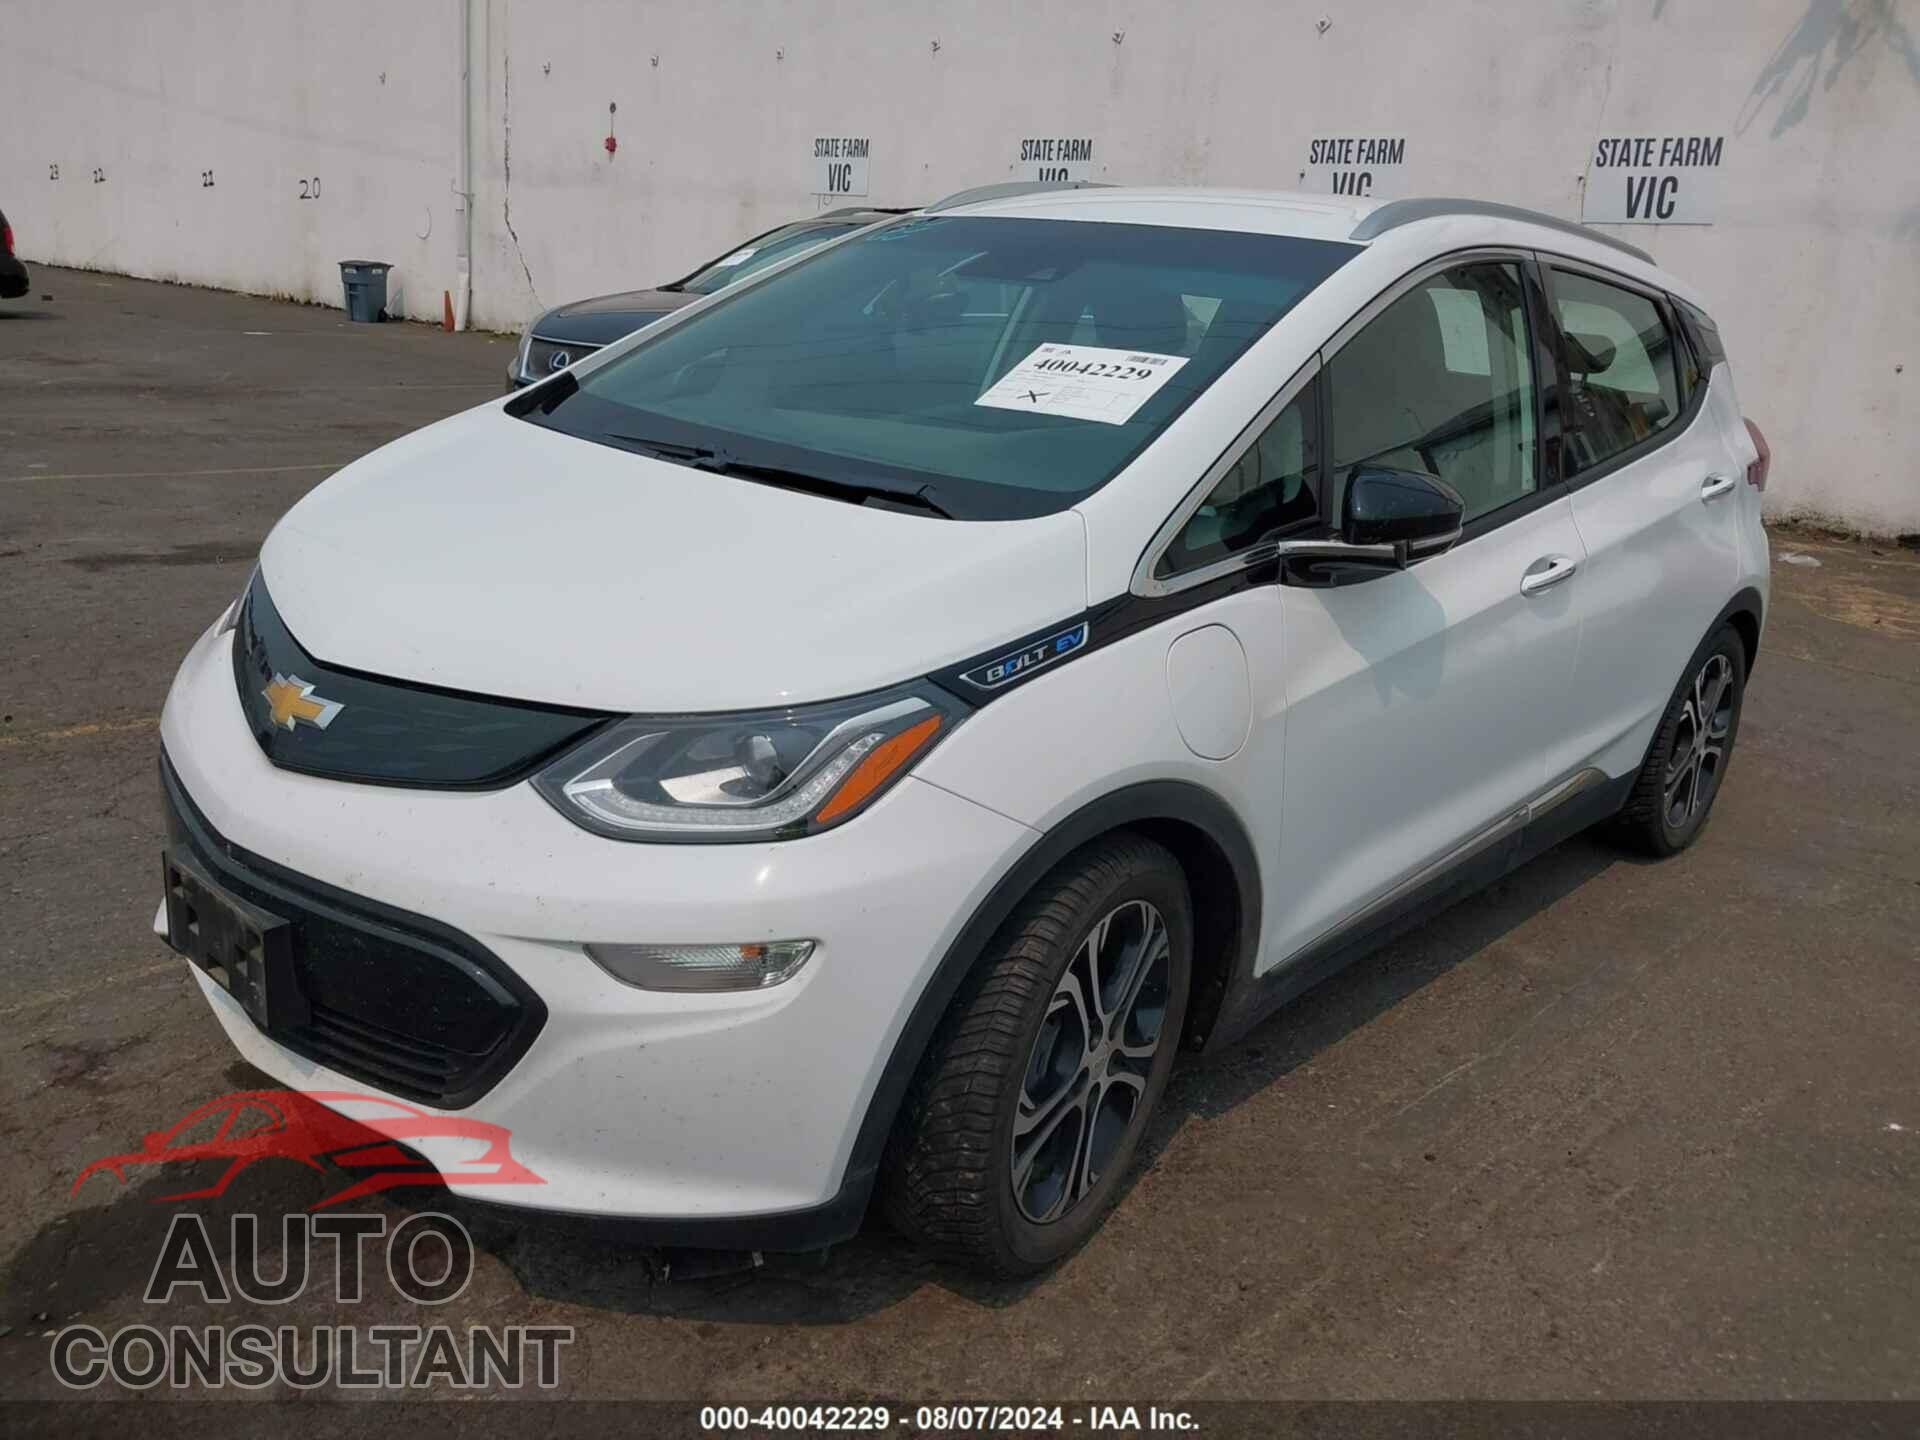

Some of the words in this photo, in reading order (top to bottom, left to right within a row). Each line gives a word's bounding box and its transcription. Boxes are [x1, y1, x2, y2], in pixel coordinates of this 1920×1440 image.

[815, 138, 840, 158] STATE
[842, 138, 869, 158] FARM
[1021, 139, 1054, 161] STATE
[1057, 139, 1092, 161] FARM
[1310, 138, 1354, 165] STATE
[1356, 138, 1405, 164] FARM
[1596, 138, 1656, 167] STATE
[1659, 137, 1724, 167] FARM
[298, 177, 320, 199] 20
[828, 163, 851, 192] VIC
[1333, 172, 1372, 197] VIC
[1626, 176, 1678, 219] VIC
[1034, 358, 1153, 382] 40042229
[987, 645, 1048, 682] BOLT
[1055, 629, 1082, 652] EV
